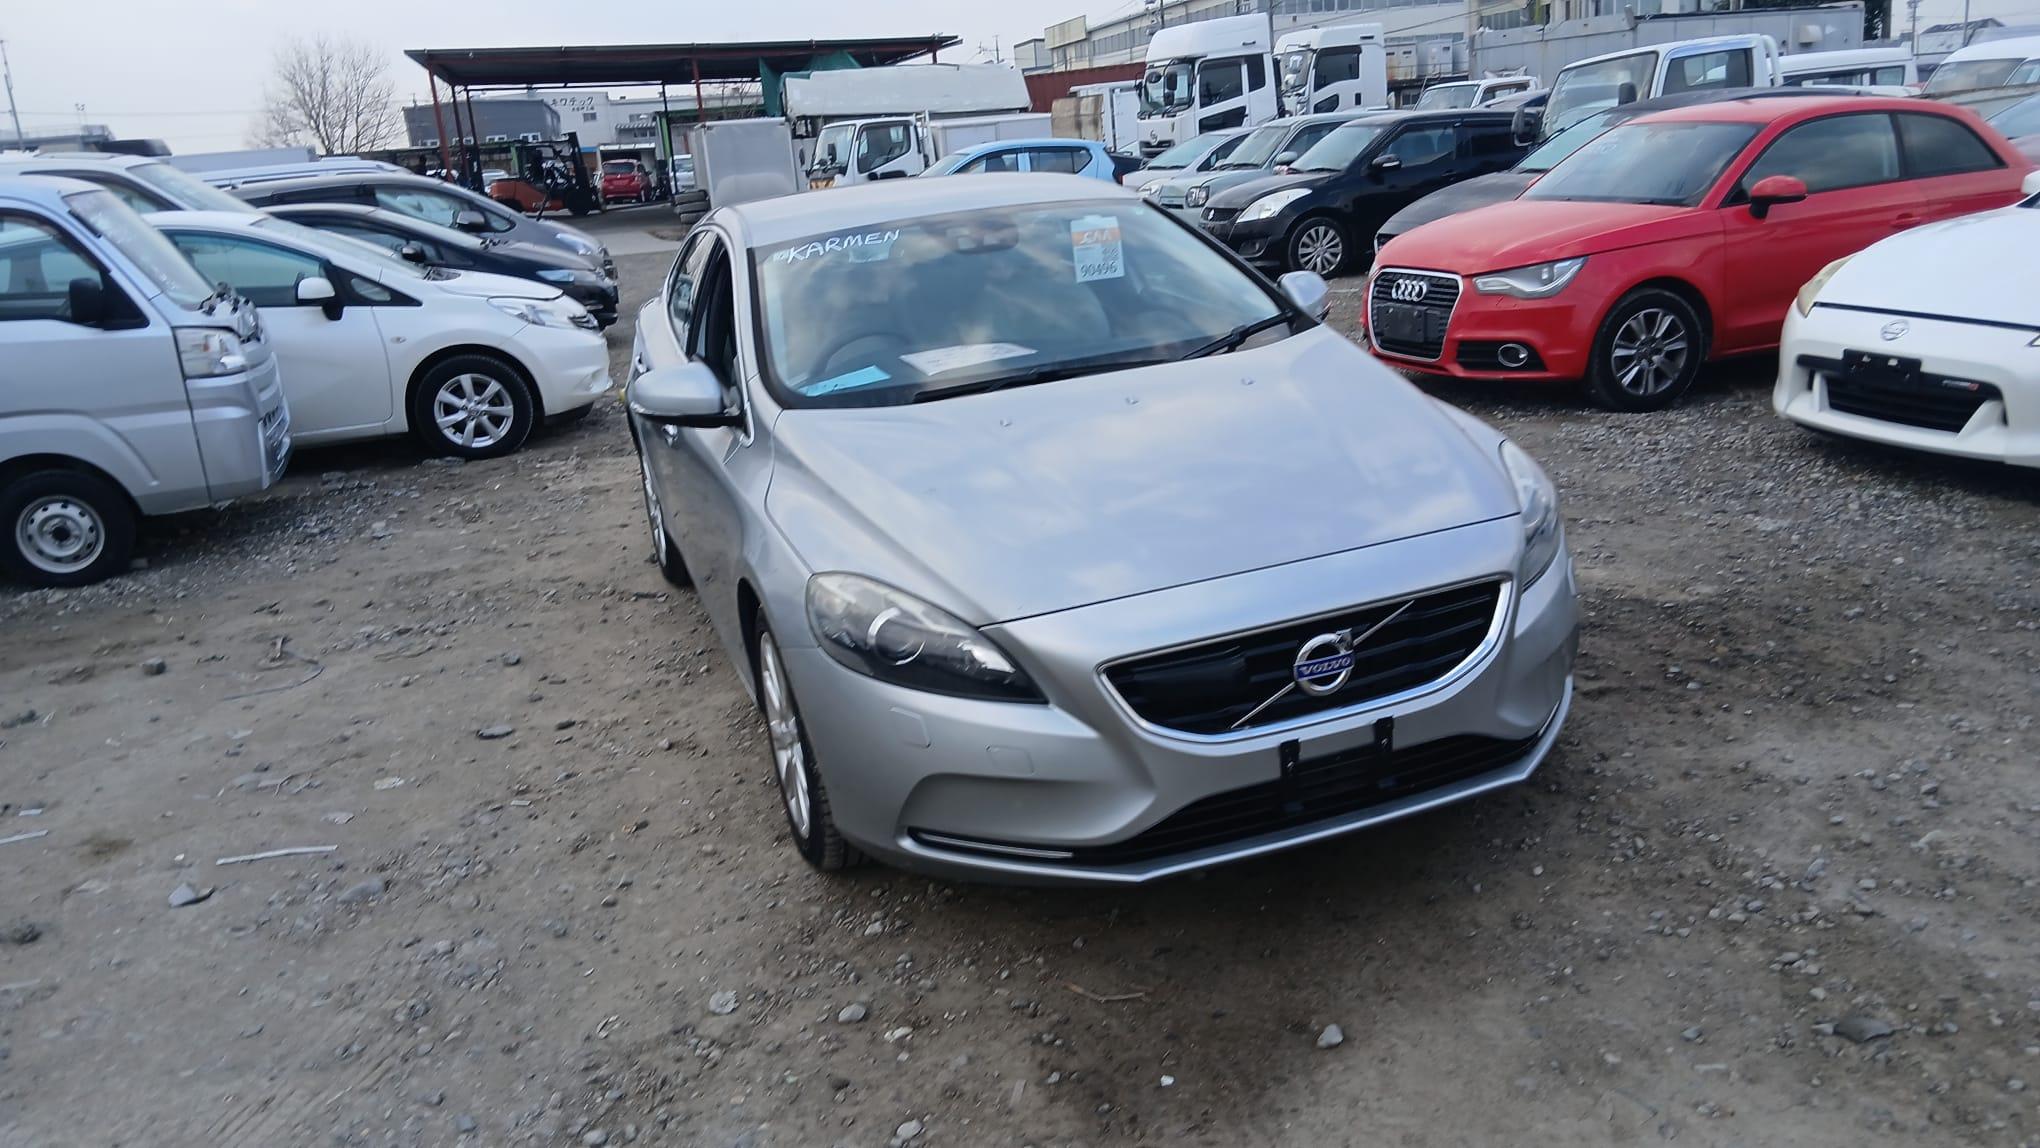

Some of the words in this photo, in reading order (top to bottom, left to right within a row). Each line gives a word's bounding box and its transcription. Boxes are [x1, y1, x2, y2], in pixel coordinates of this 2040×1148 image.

[787, 229, 900, 264] KARMEN
[1080, 260, 1118, 278] 90496
[1299, 656, 1352, 675] VOLVO
